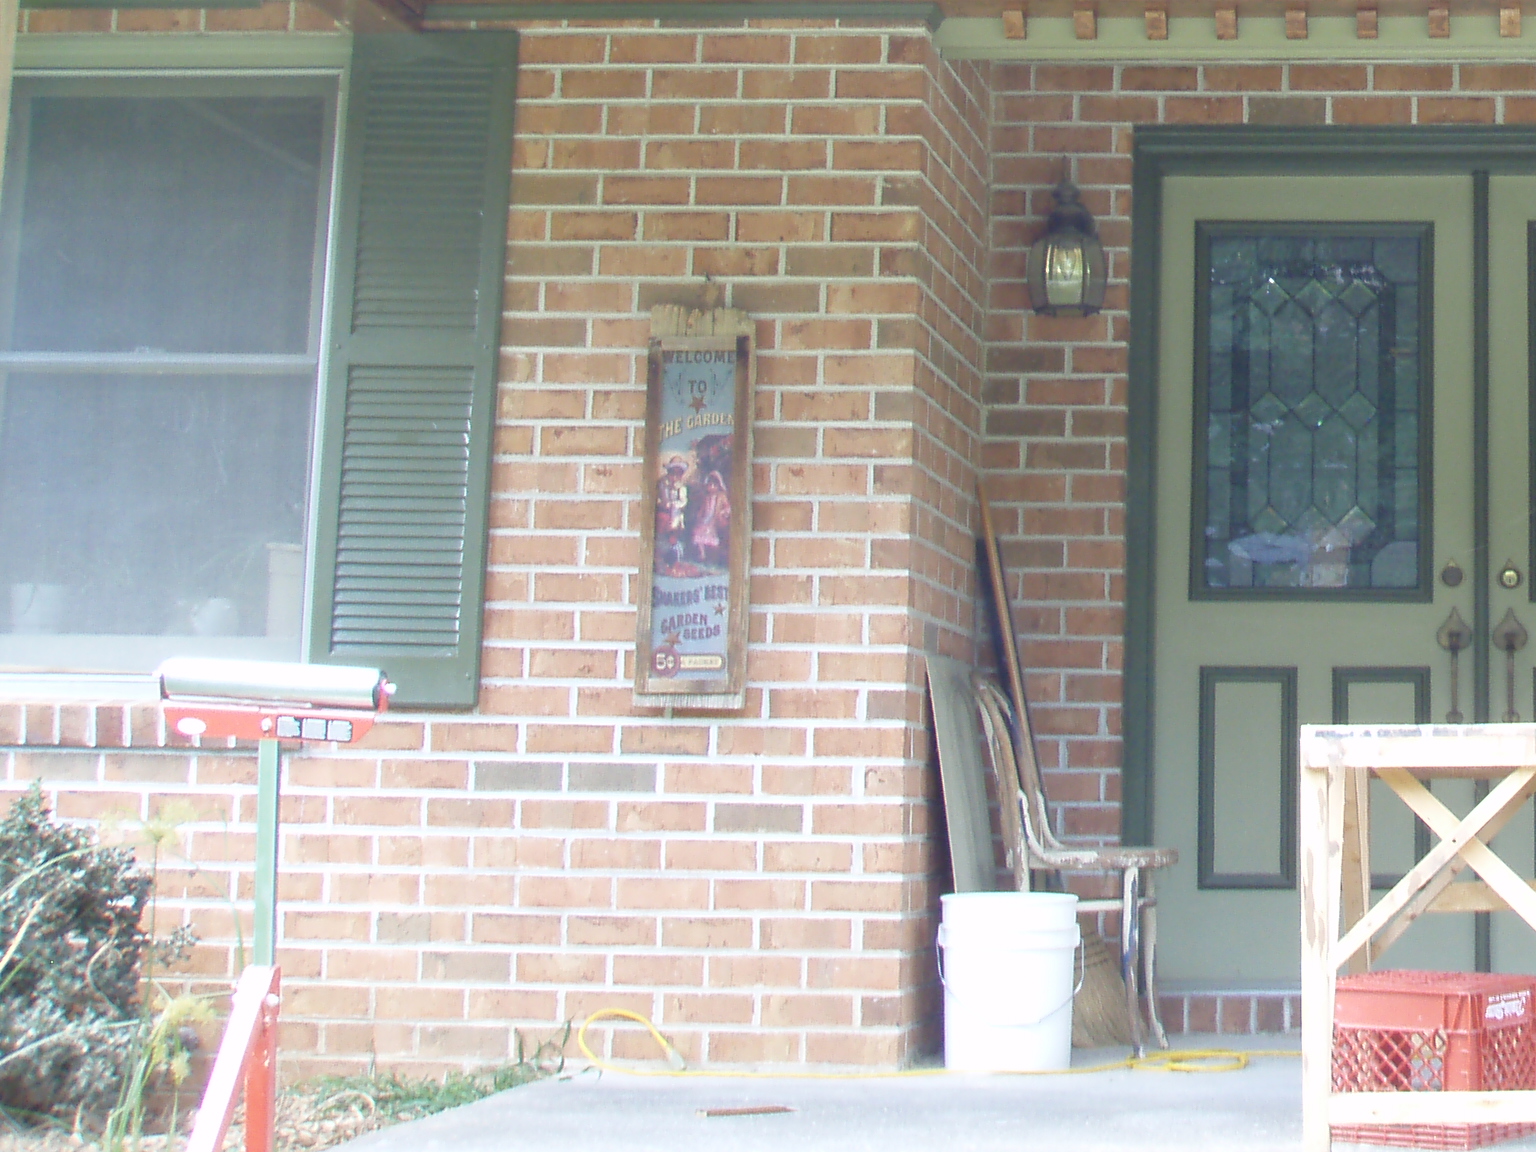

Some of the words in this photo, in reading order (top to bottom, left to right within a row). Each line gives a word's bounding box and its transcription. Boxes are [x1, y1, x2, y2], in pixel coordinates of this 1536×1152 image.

[662, 350, 735, 364] WELCOME
[688, 380, 707, 394] TO
[660, 417, 682, 442] THE
[686, 412, 734, 430] GARDEN
[661, 613, 707, 634] GARDEN
[683, 624, 720, 640] SEEDS
